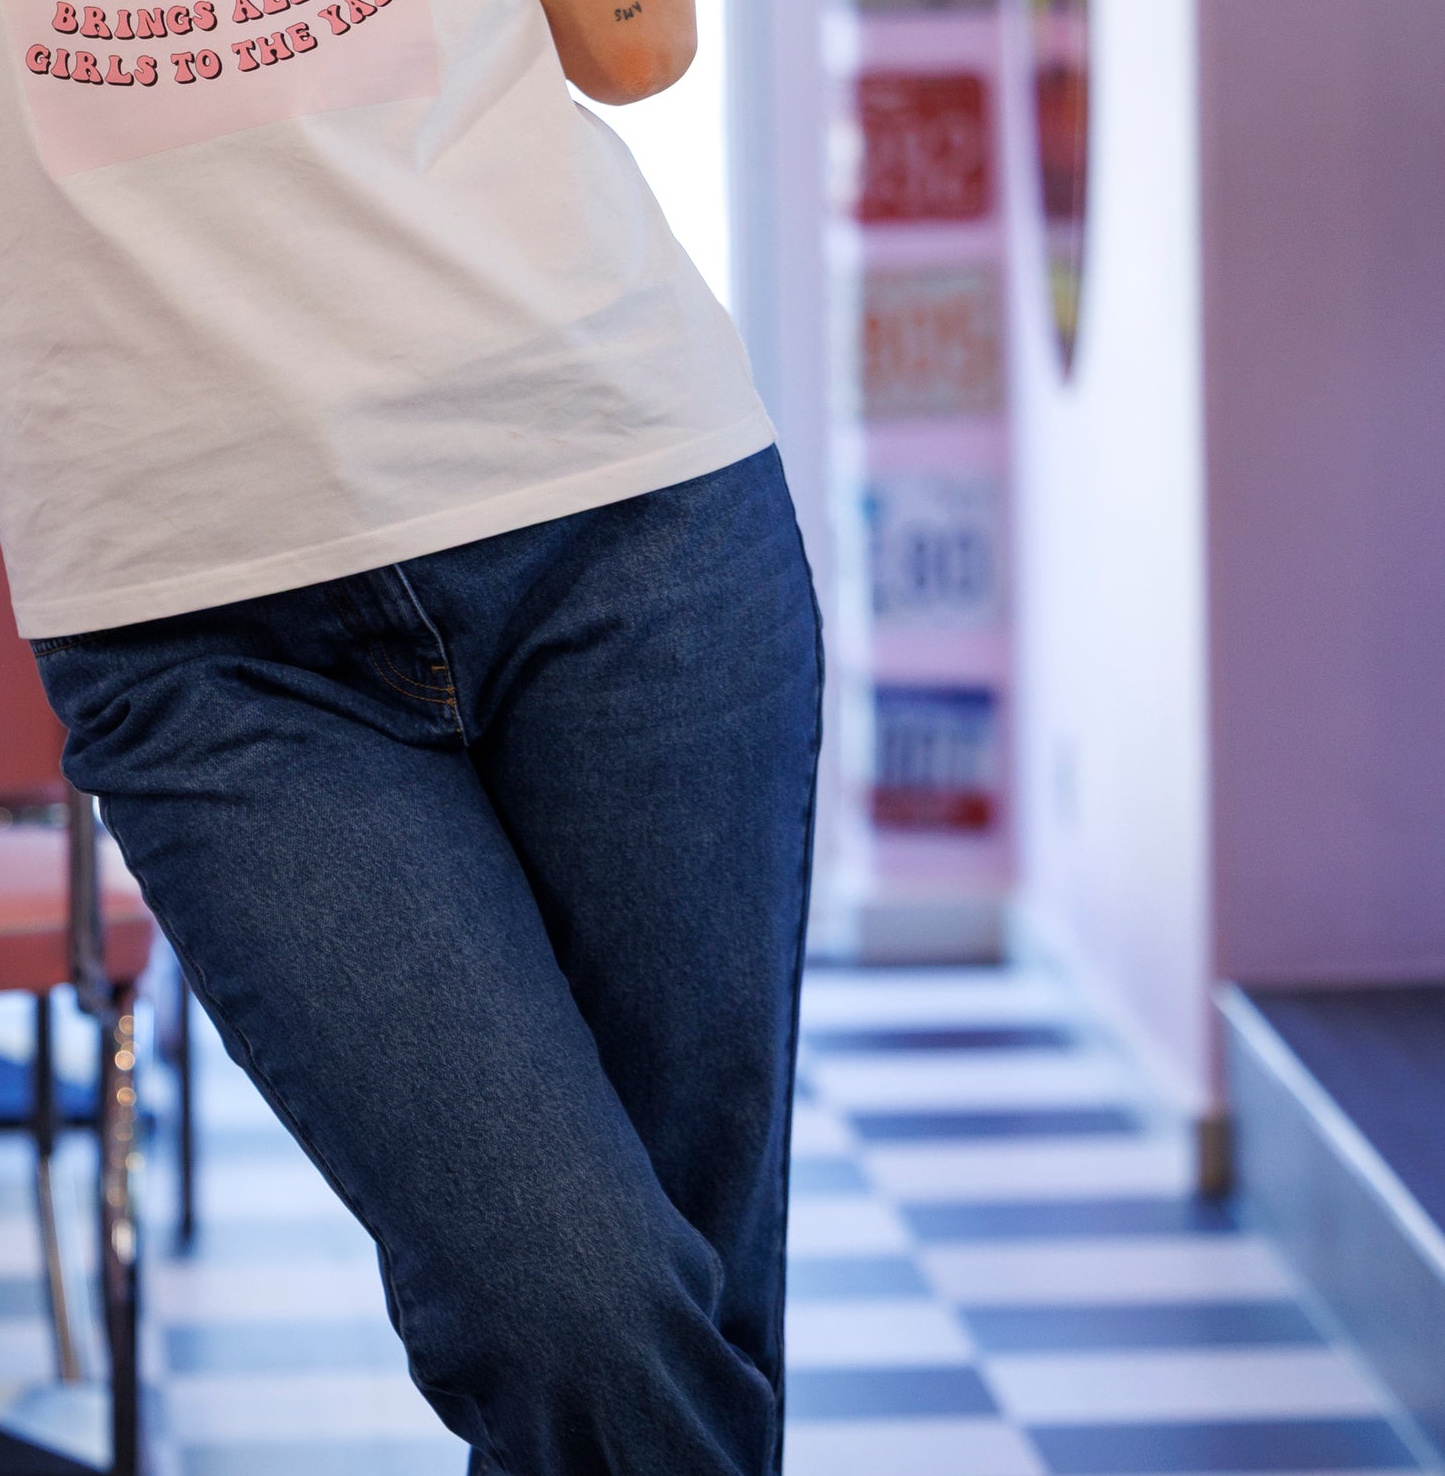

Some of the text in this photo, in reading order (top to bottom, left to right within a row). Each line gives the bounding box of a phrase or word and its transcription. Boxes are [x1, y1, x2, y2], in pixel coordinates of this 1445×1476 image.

[52, 1, 217, 40] BRINGS
[25, 43, 157, 86] GIRLS
[170, 48, 222, 84] TO
[231, 22, 318, 72] THE
